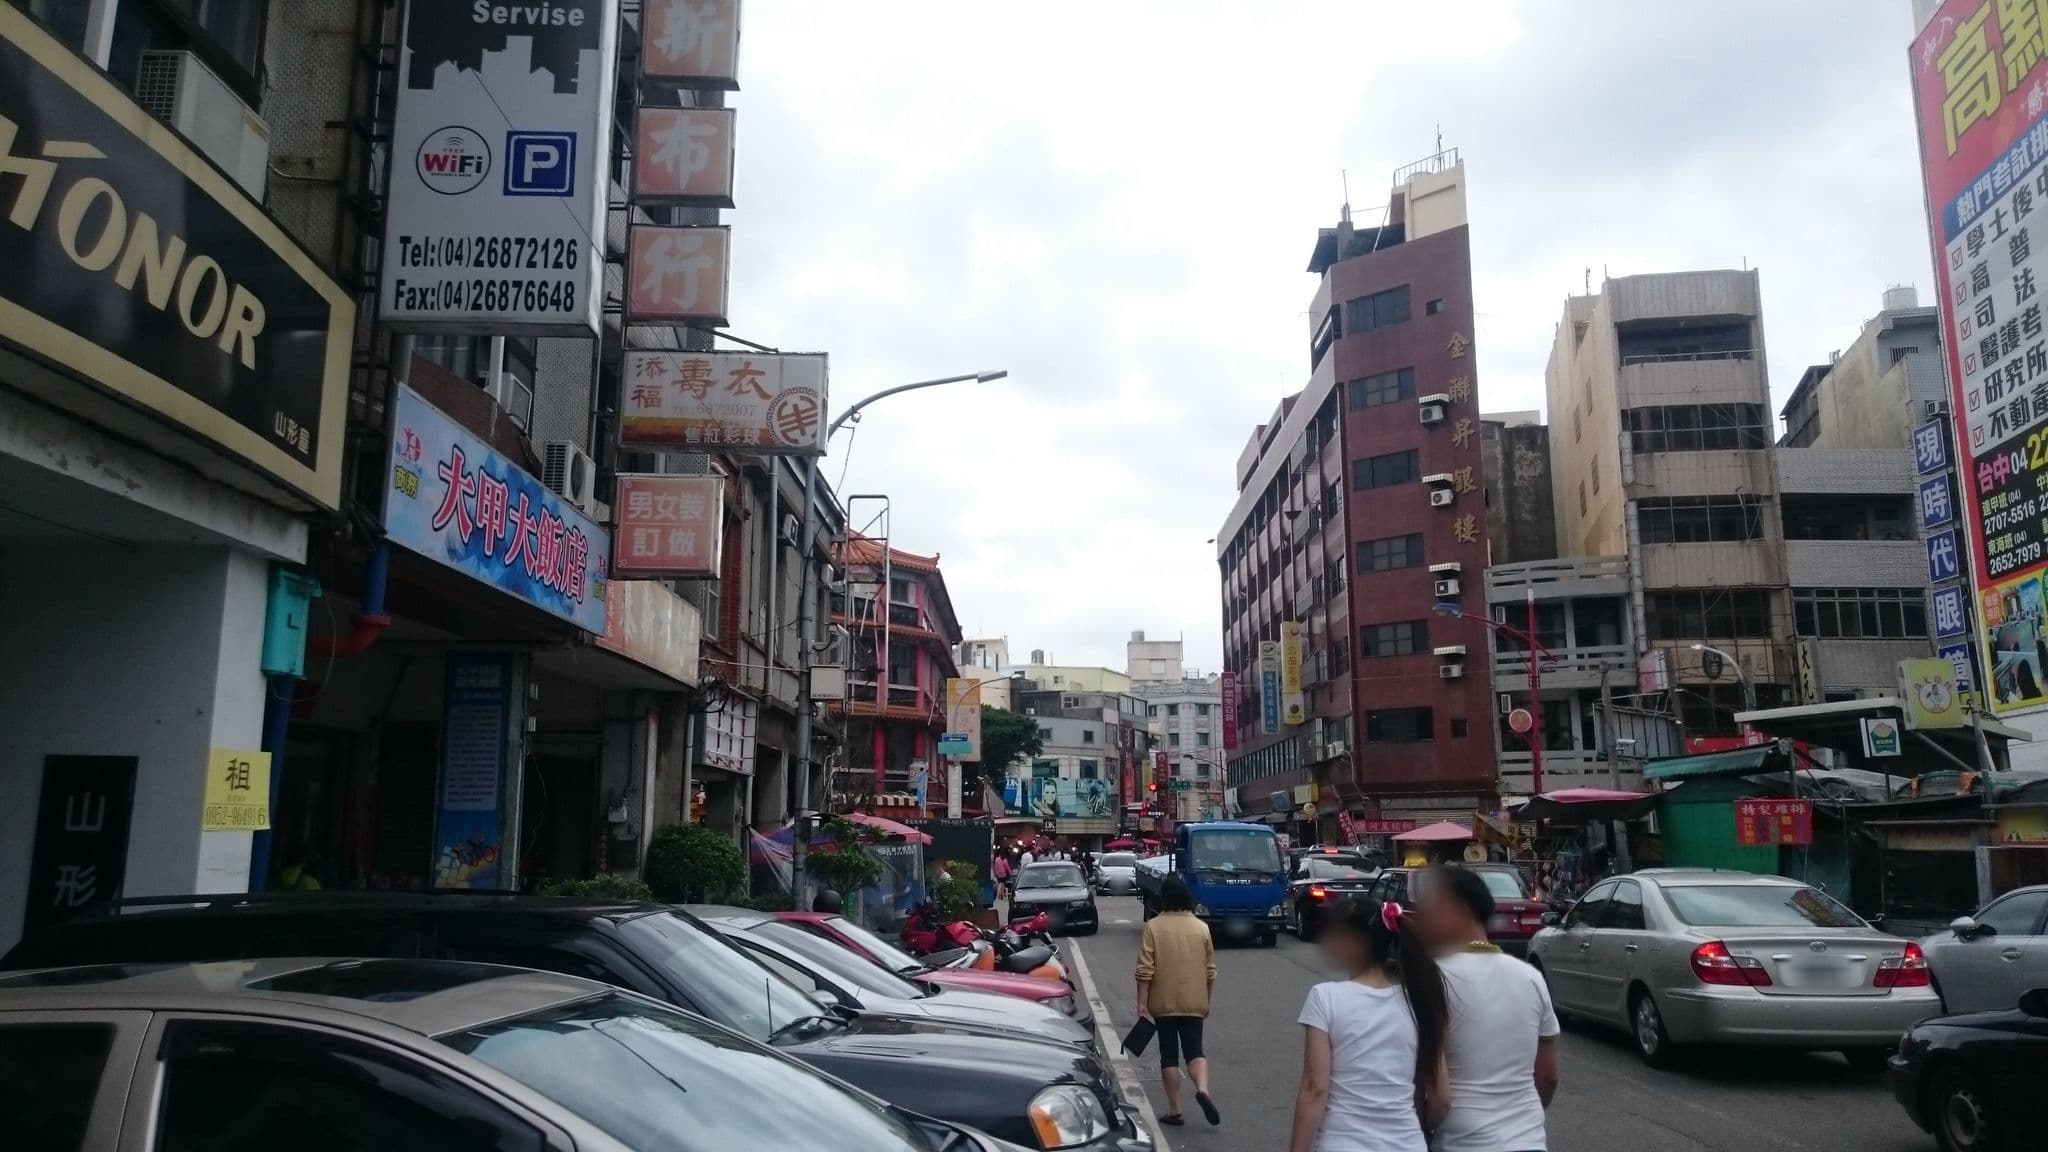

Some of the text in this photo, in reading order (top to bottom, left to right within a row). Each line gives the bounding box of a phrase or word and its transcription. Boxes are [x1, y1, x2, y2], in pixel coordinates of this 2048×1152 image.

[472, 0, 585, 27] Servise
[424, 153, 483, 174] WiFi
[523, 144, 560, 183] P
[432, 446, 590, 603] 大甲大飯店
[1984, 501, 2036, 535] 2707-5516
[1989, 542, 2041, 576] 2652-7979
[225, 758, 252, 792] 租
